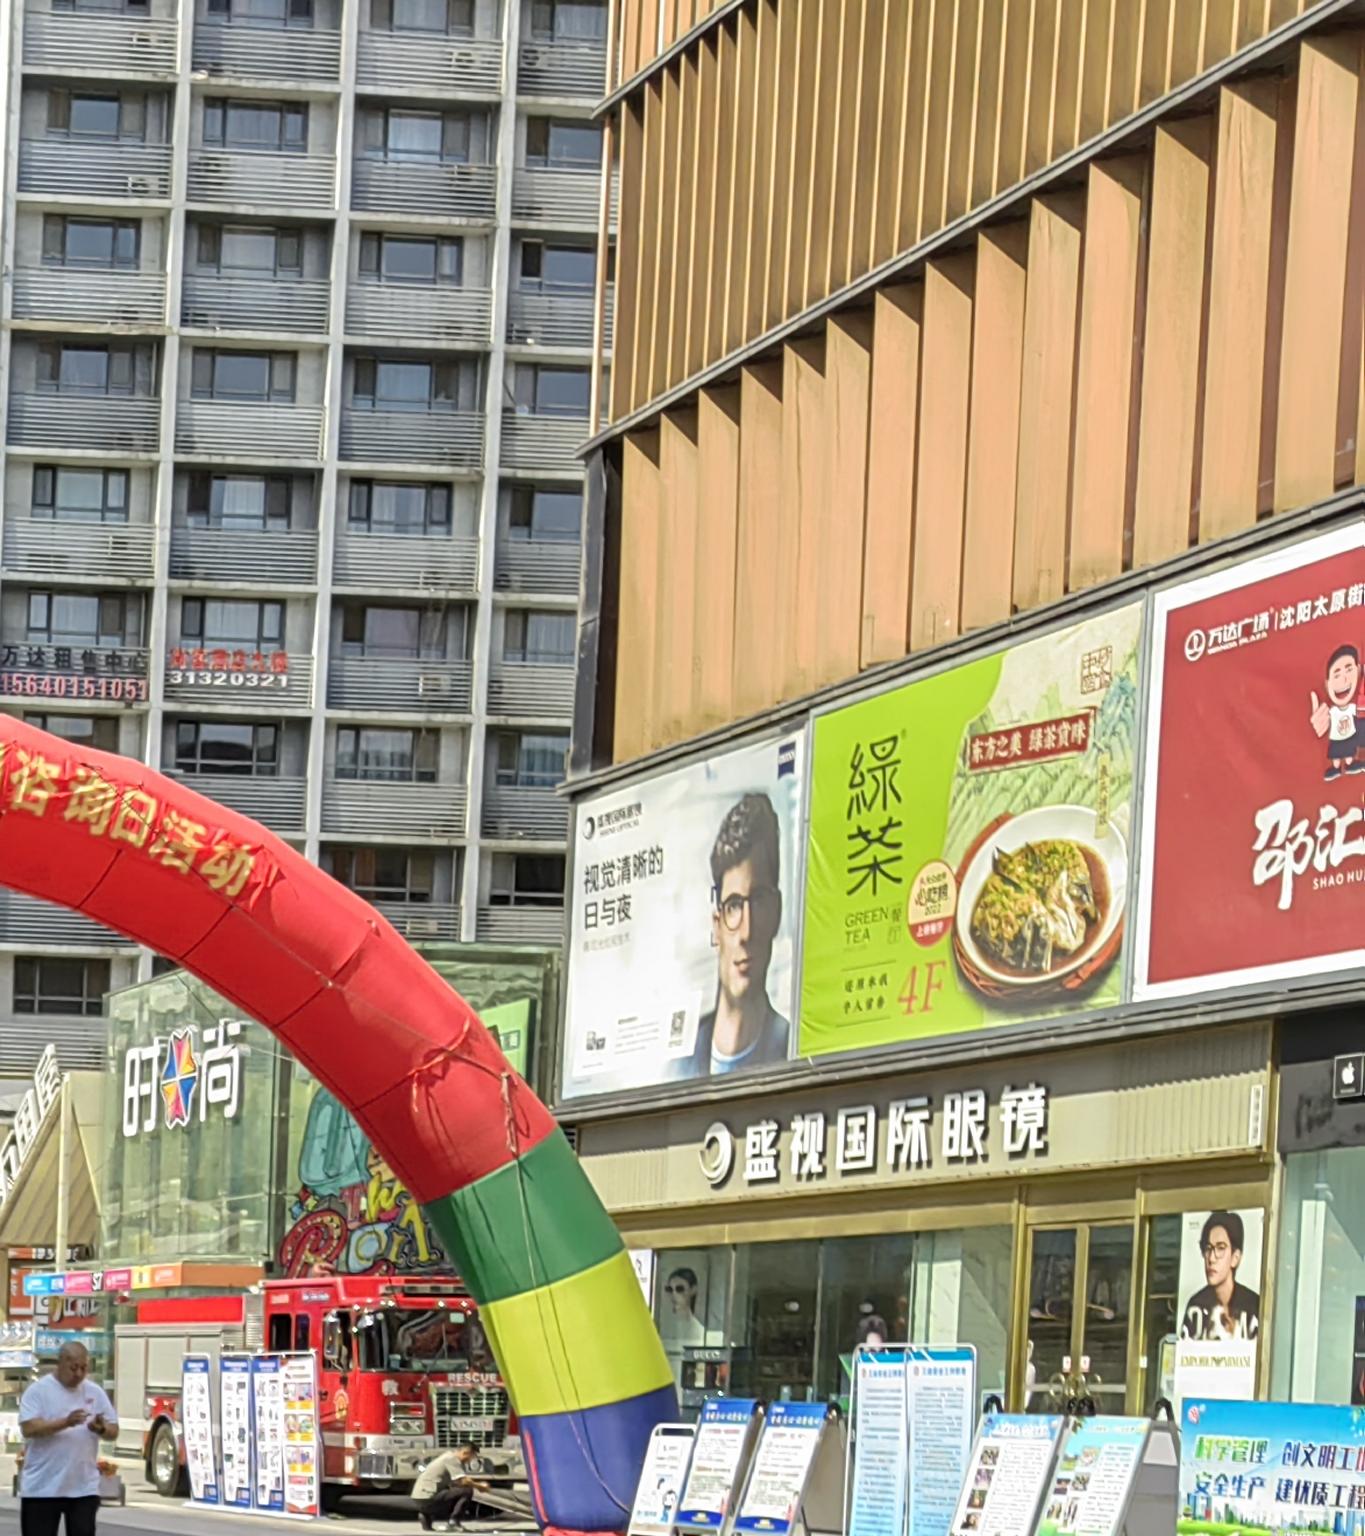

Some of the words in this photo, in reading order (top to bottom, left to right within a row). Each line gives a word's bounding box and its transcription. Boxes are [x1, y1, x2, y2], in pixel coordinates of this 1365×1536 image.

[1208, 611, 1269, 647] 万达广场
[1279, 583, 1365, 629] 沈阳太原街
[170, 671, 288, 688] 31320321
[584, 844, 663, 894] 视觉清晰的
[1313, 872, 1344, 890] SHAO
[1347, 868, 1365, 883] HU
[584, 894, 632, 930] 日与夜
[845, 907, 888, 928] GREEN
[846, 929, 870, 944] TEA
[897, 960, 947, 1015] 4F
[743, 1084, 1047, 1181] 盛视国际眼镜
[447, 1372, 498, 1384] RESCUE
[1195, 1436, 1268, 1464] 科学管理
[1194, 1471, 1267, 1499] 安全生产
